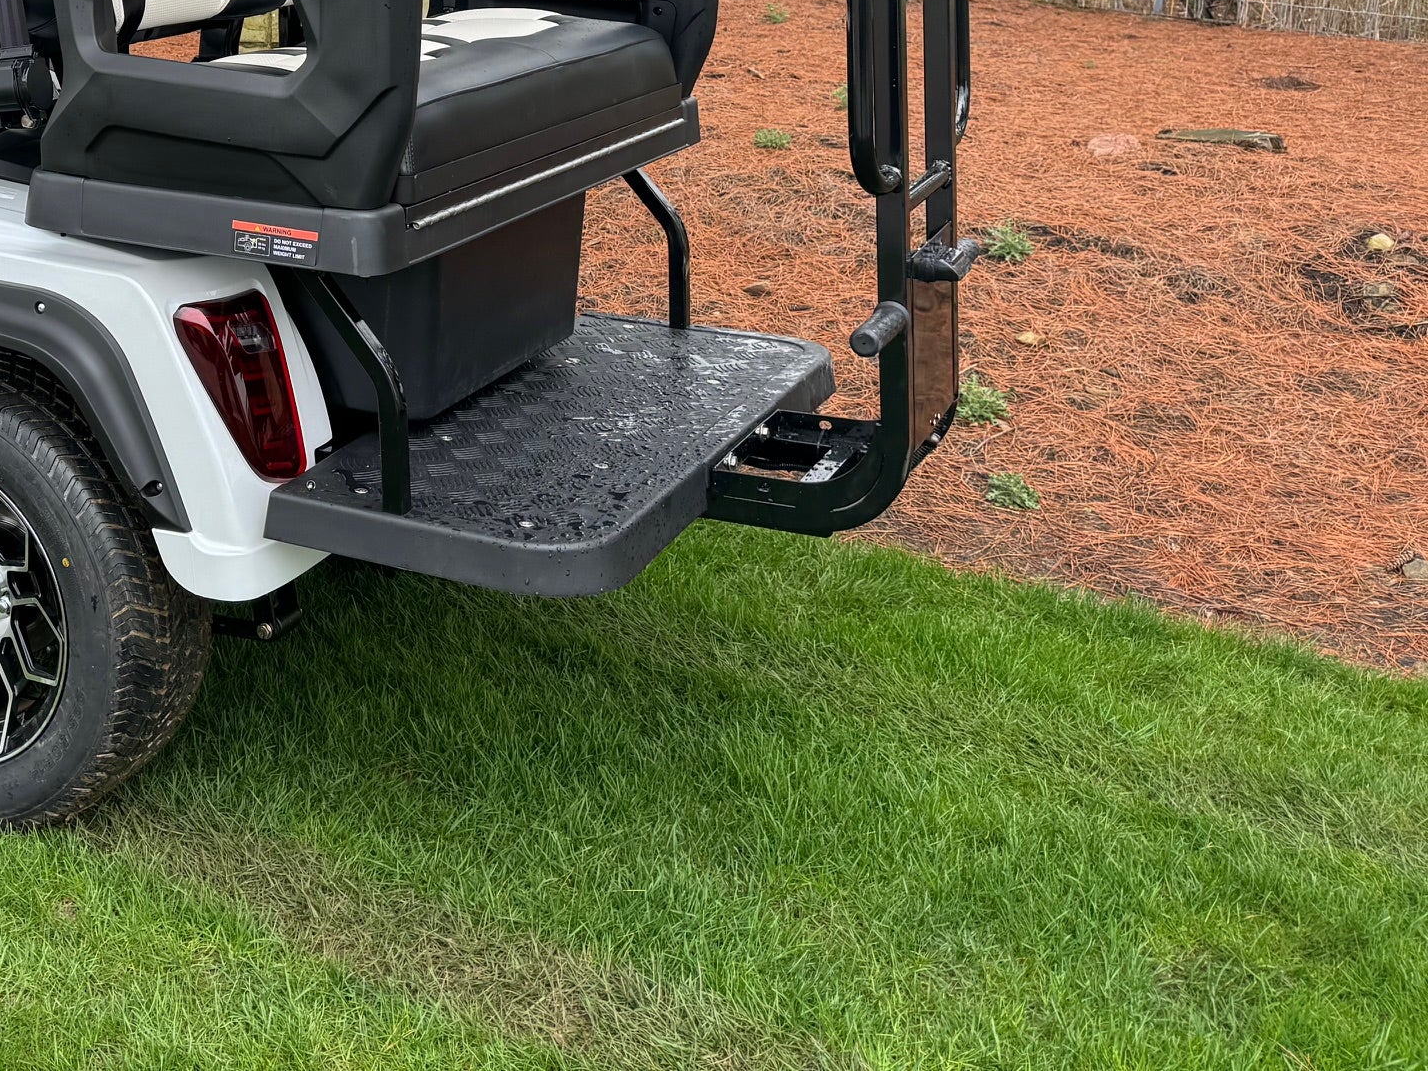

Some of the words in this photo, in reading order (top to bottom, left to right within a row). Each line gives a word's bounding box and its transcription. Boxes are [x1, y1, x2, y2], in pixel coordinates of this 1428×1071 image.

[262, 226, 292, 236] WARNING
[273, 244, 297, 252] MAXIMUM
[292, 241, 313, 249] EXCEED
